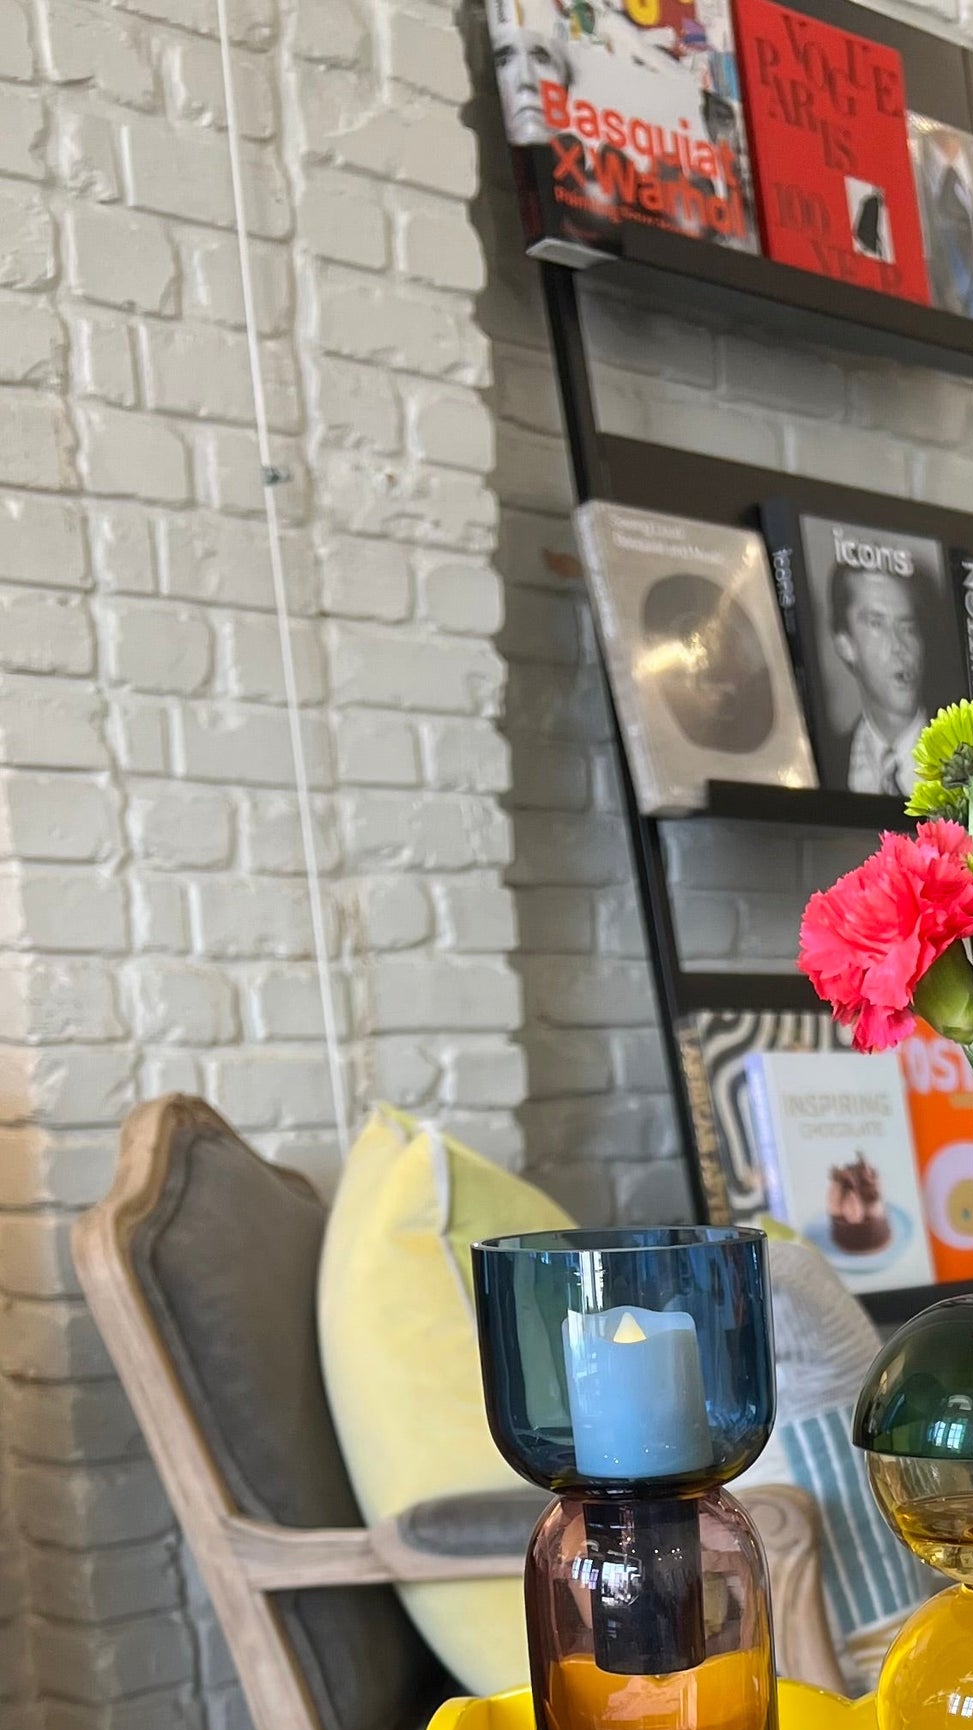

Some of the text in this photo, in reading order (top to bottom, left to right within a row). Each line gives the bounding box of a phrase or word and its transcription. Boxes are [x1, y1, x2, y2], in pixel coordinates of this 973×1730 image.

[782, 14, 903, 118] VOGUE
[539, 79, 739, 188] Basquiat
[589, 147, 747, 238] Warhol
[772, 548, 796, 608] icons
[832, 527, 914, 577] icons
[784, 1093, 893, 1117] INSPIRING
